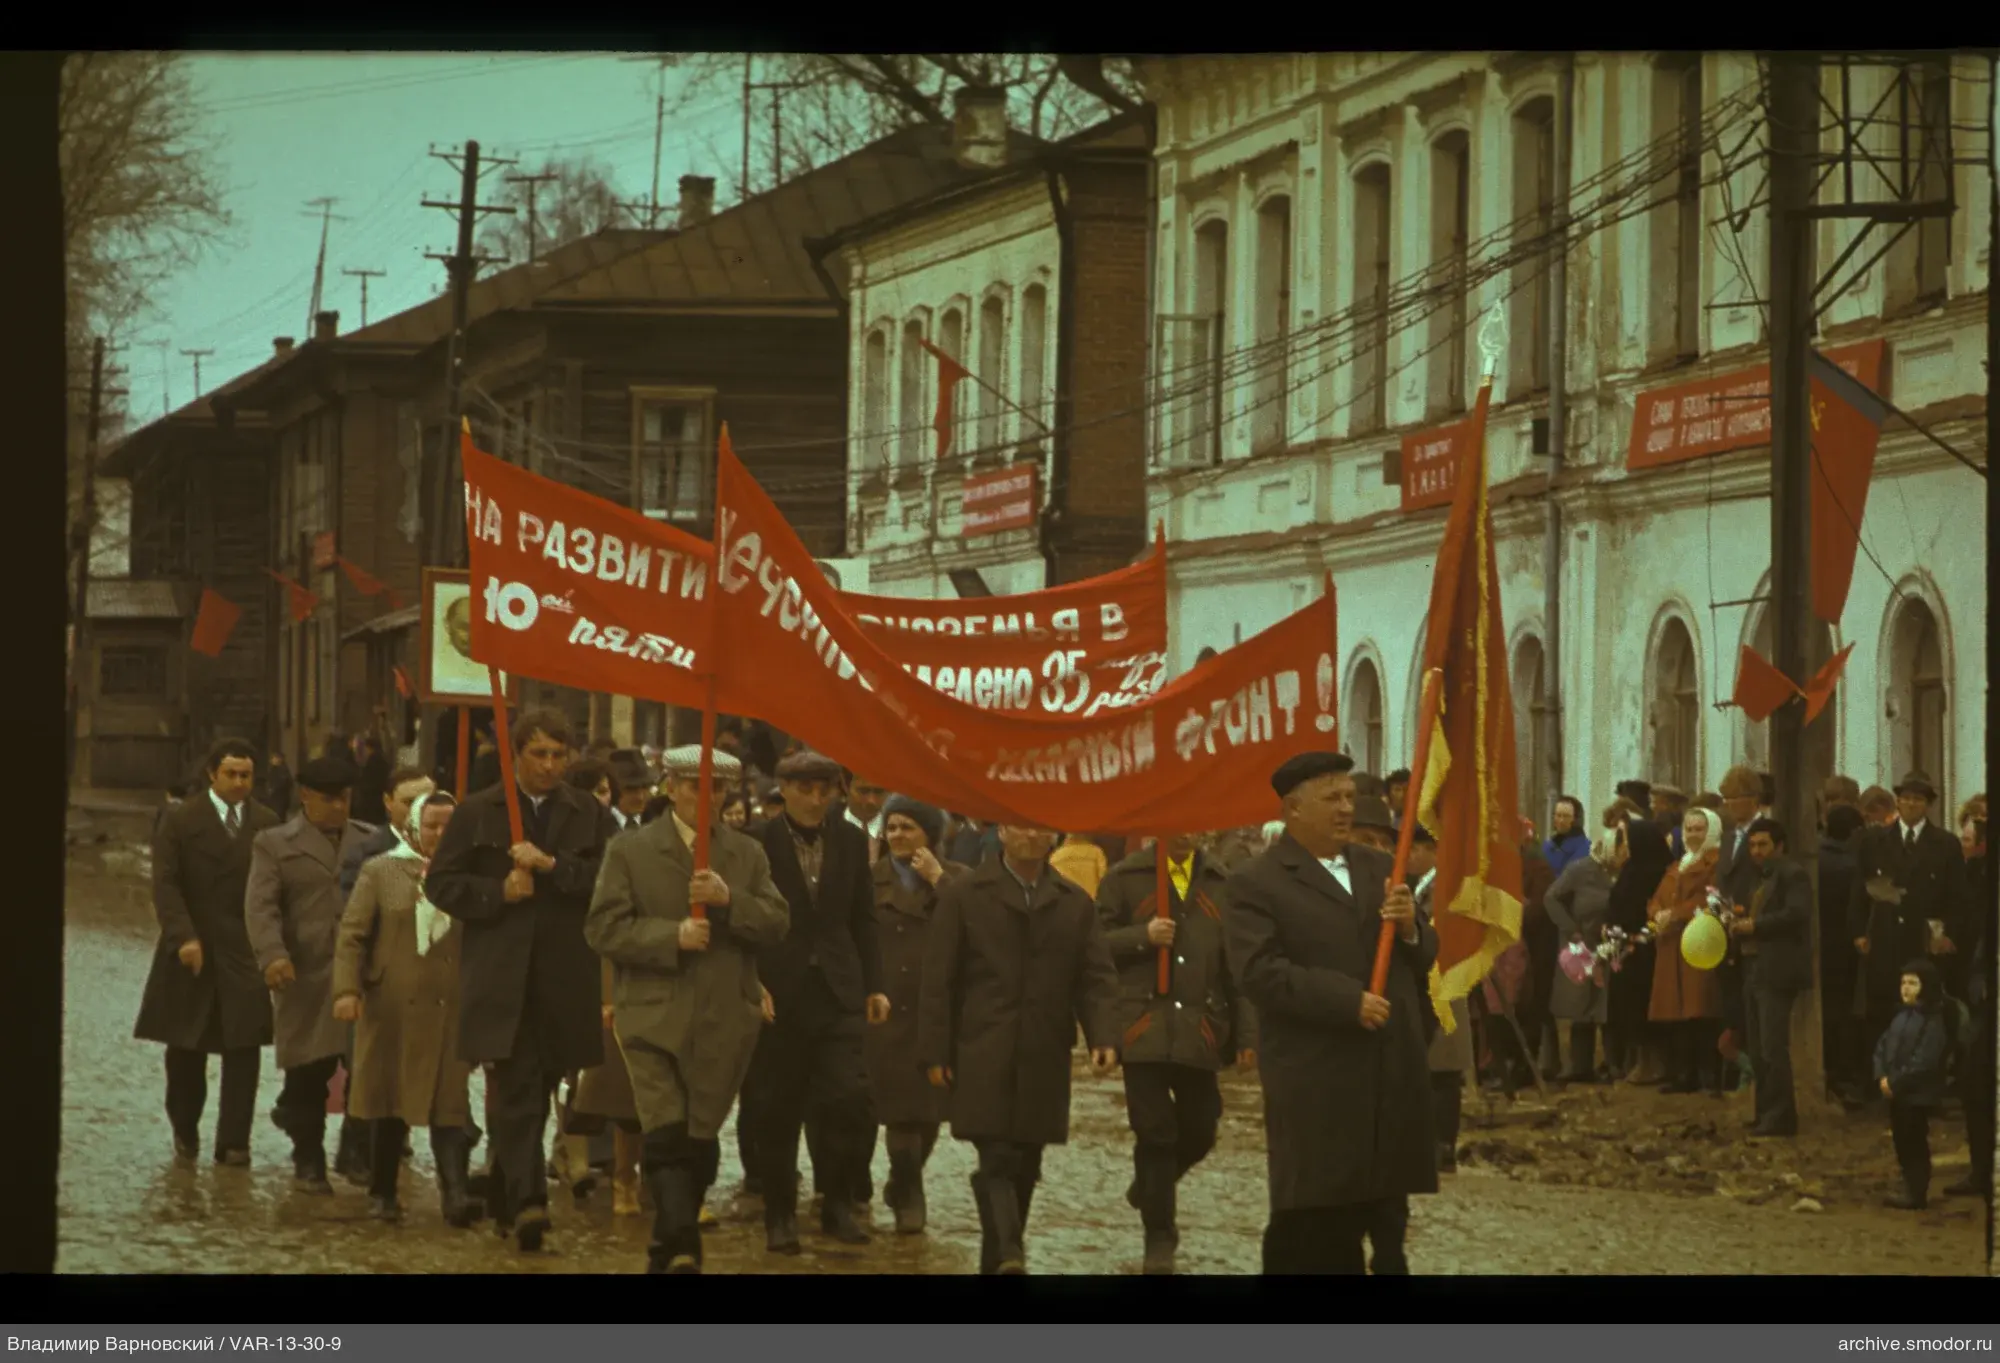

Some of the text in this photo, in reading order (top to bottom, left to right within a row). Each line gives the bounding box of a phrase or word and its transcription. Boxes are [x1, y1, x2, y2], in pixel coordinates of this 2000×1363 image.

[464, 481, 503, 546] НА
[517, 510, 707, 600] РАЗВИТИ
[1100, 602, 1129, 641] В
[568, 616, 696, 670] пяти
[1040, 650, 1091, 714] 35
